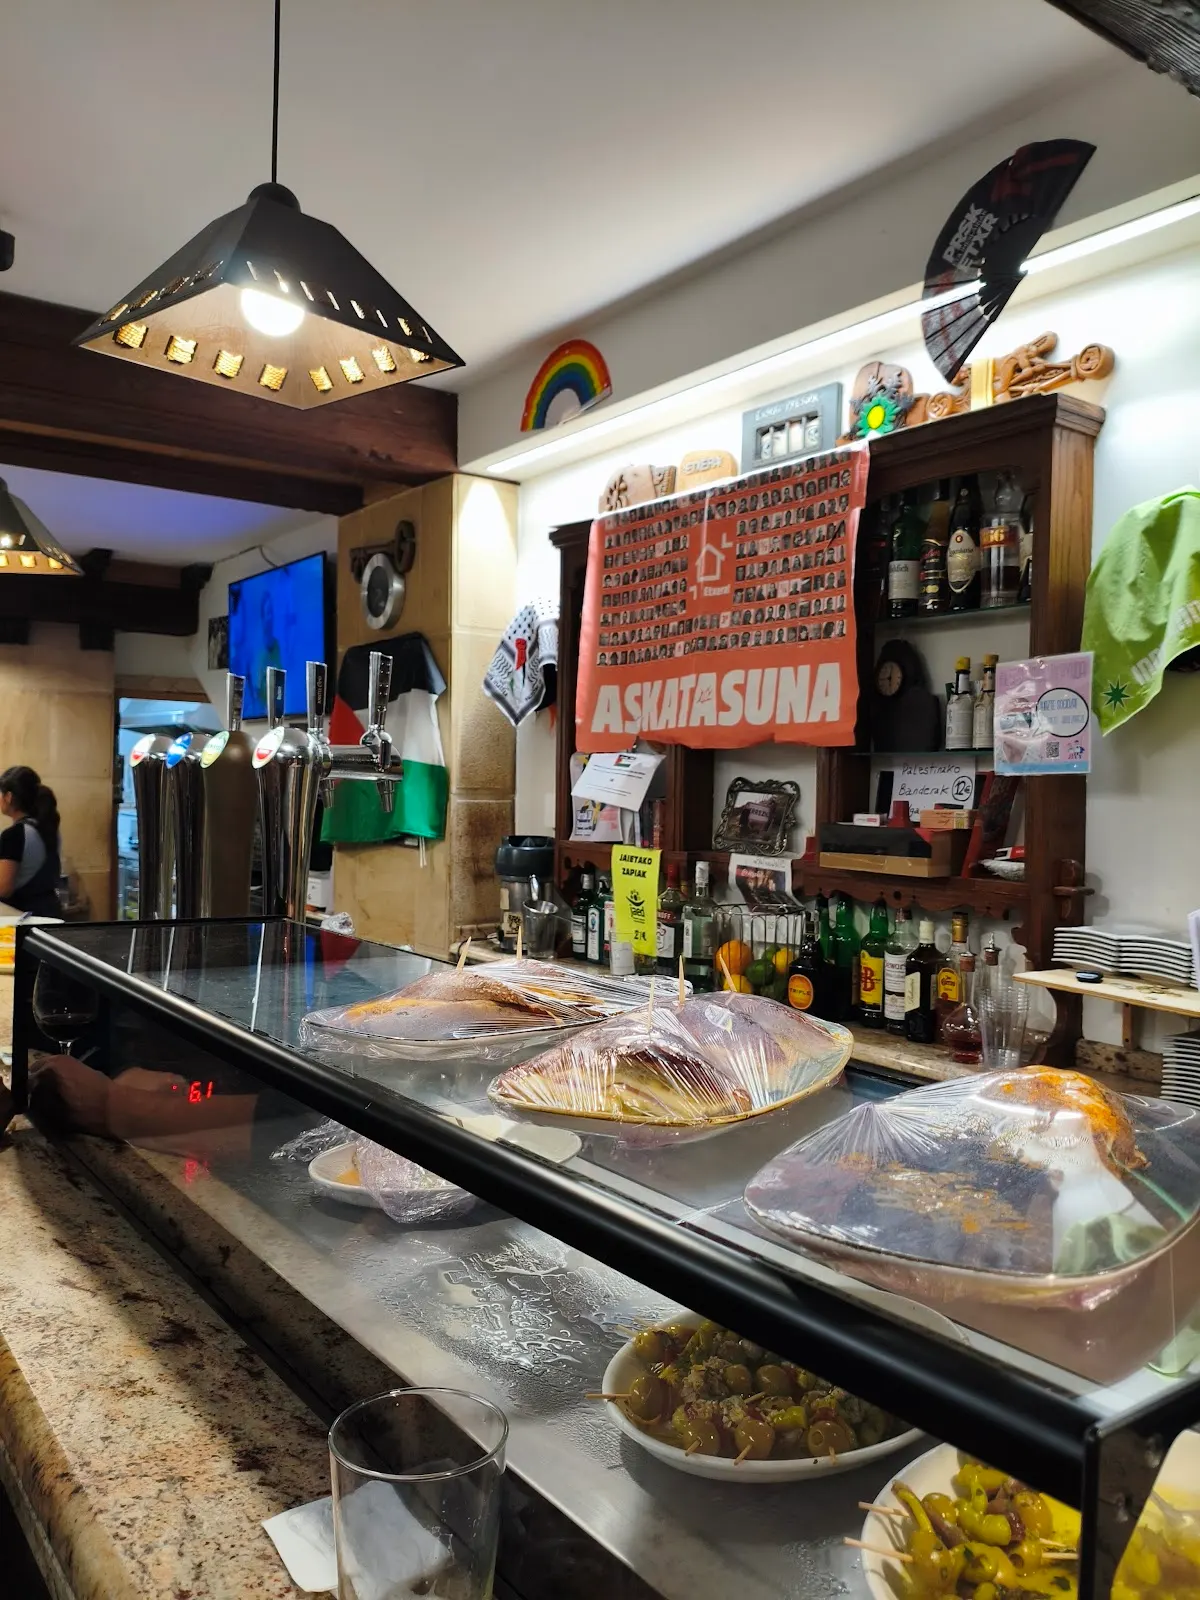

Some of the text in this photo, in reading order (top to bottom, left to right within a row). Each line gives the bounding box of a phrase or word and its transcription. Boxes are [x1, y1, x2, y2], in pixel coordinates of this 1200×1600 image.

[591, 662, 841, 735] ASKATASUNA
[898, 782, 949, 797] Banderak
[619, 854, 652, 865] JAIETAKO
[622, 867, 647, 878] ZAPIAK
